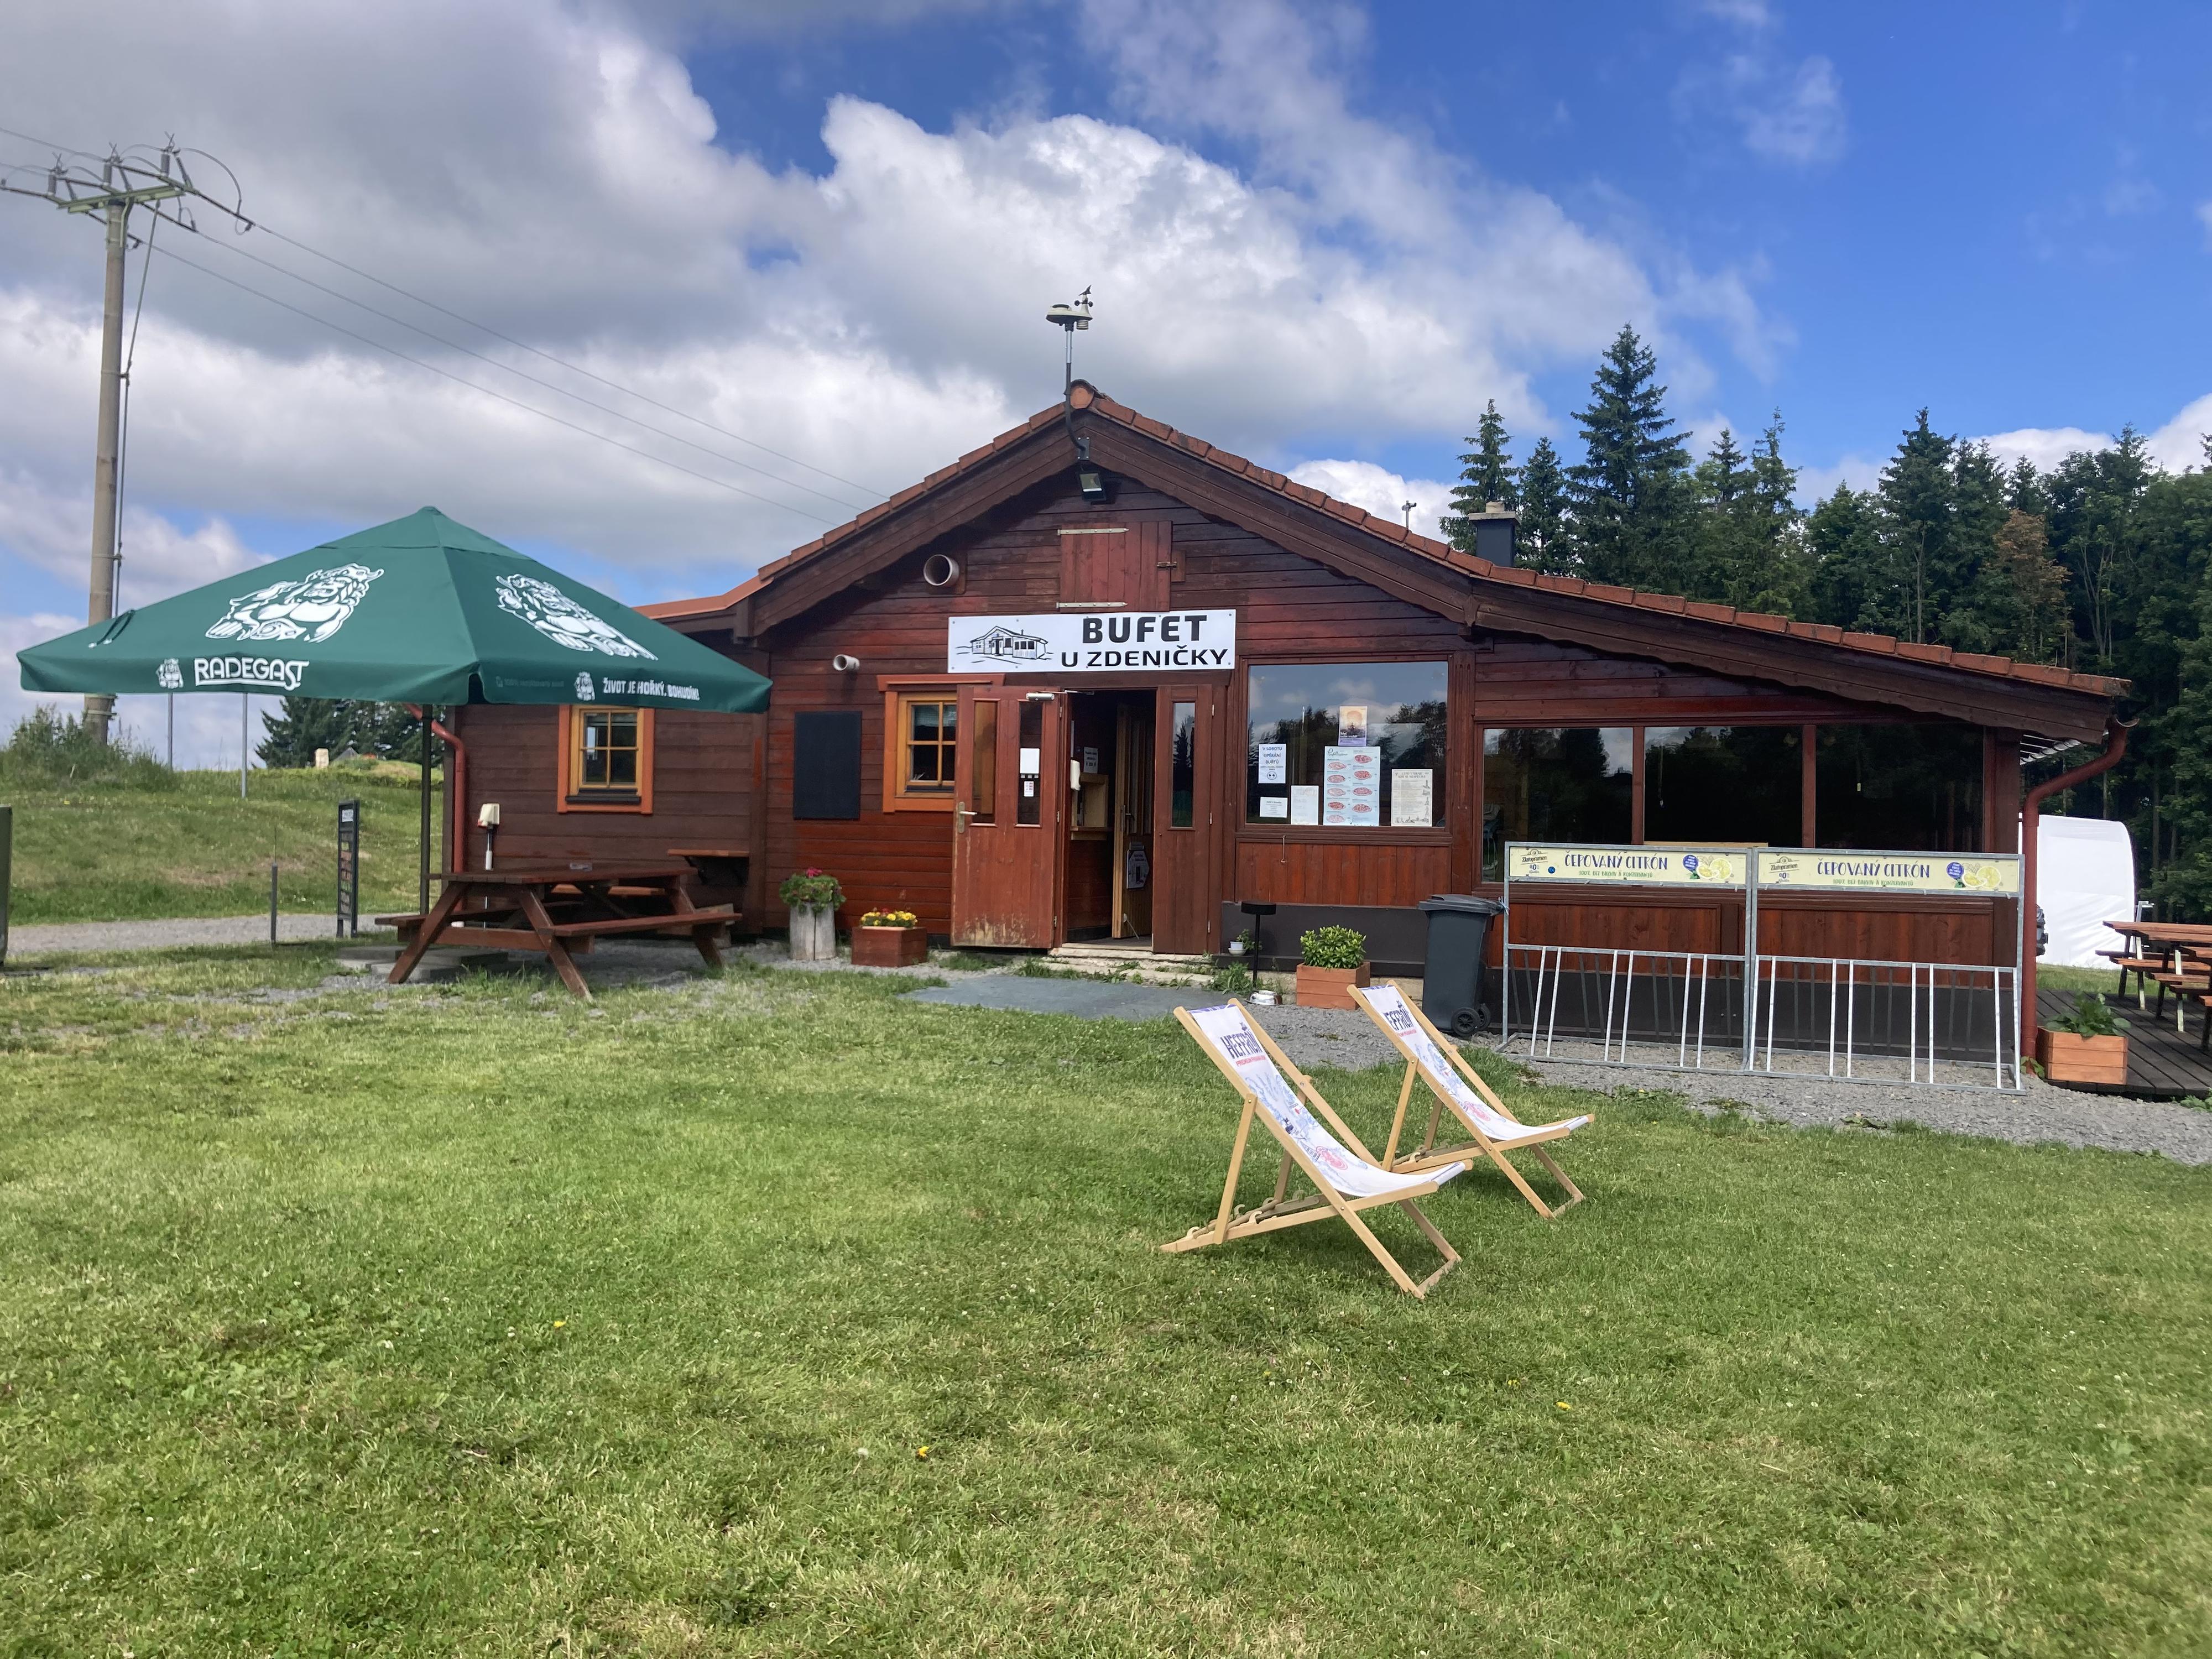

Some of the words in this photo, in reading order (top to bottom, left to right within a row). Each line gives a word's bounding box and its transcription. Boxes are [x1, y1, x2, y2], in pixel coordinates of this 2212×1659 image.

[1083, 614, 1207, 644] BUFET
[1061, 651, 1078, 667] U
[1087, 645, 1229, 667] ZDENIČKY
[194, 656, 310, 691] RADEGAST
[603, 677, 626, 694] ŽIVOT
[627, 680, 636, 694] JE
[637, 680, 666, 696] HOŘKÝ.
[1564, 850, 1623, 868] ČEPOVANÝ
[1625, 853, 1668, 870] CITRÓN
[1817, 858, 1881, 877] ČEPOVANÝ
[1884, 860, 1930, 878] CITRÓN
[1383, 1008, 1414, 1031] EFFRON
[1220, 1030, 1263, 1059] HEFFRON
